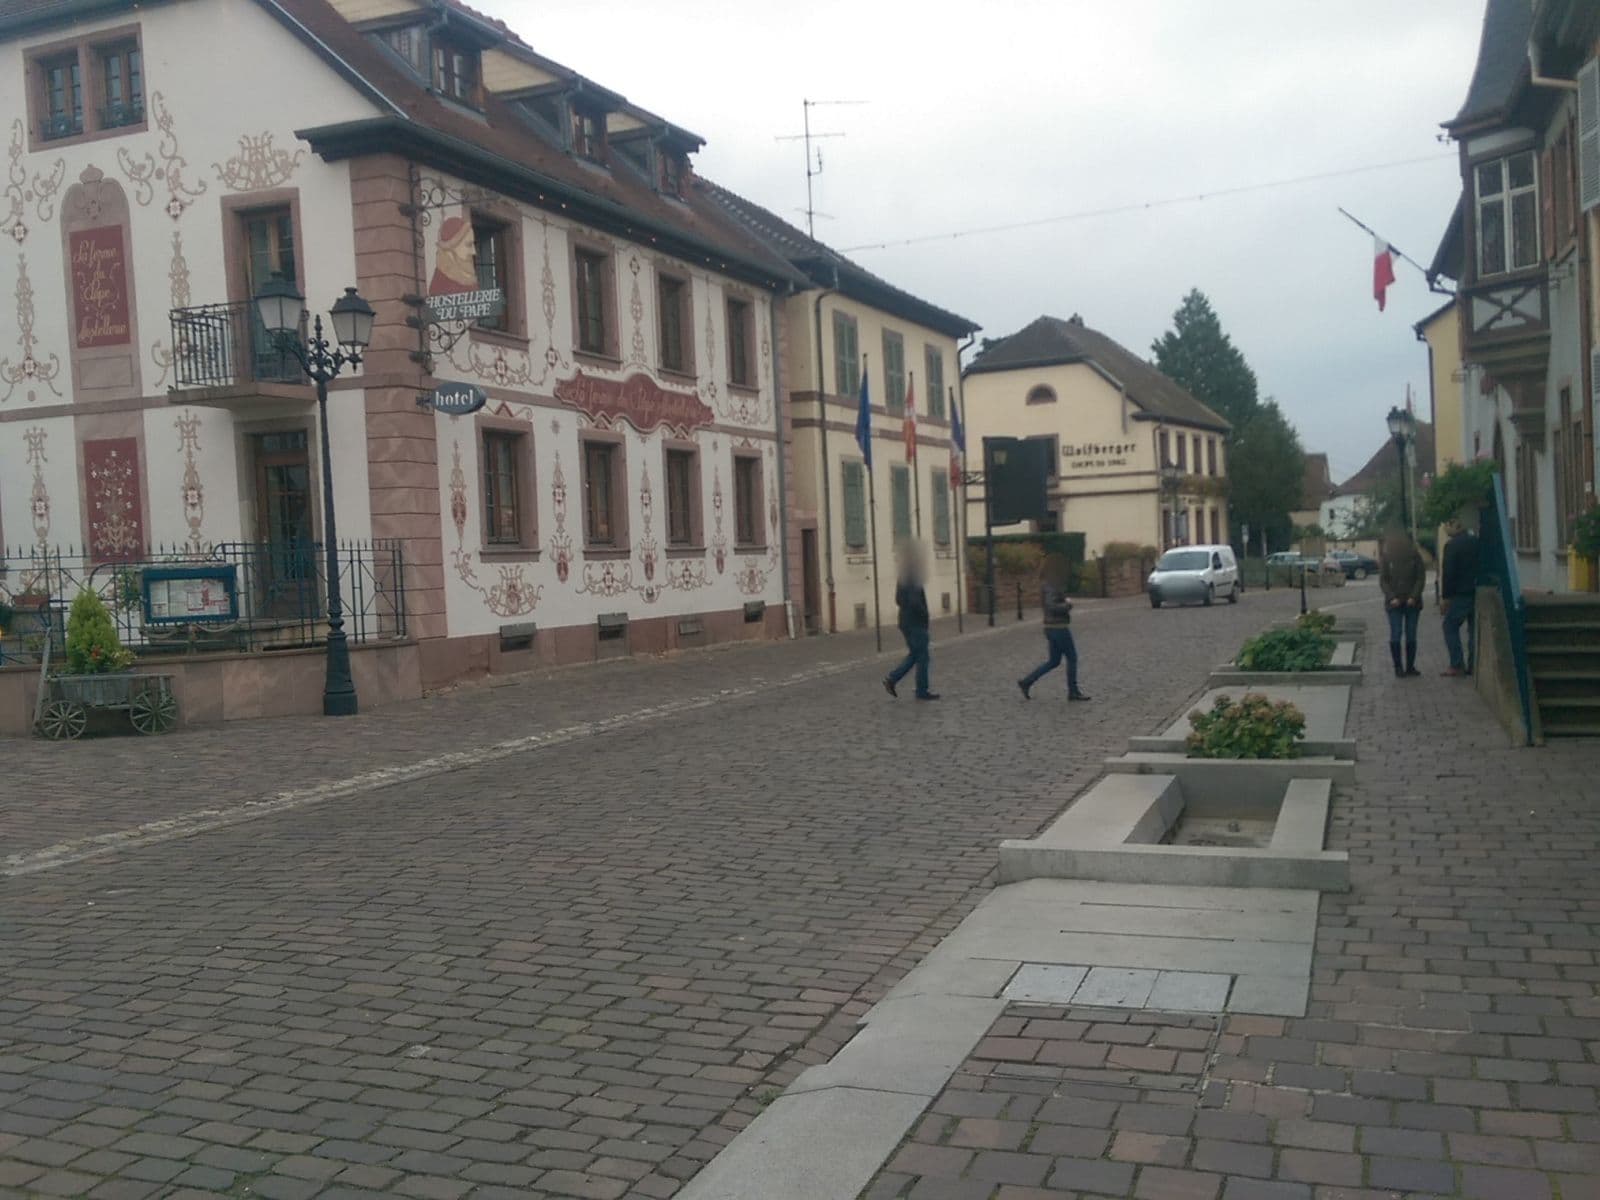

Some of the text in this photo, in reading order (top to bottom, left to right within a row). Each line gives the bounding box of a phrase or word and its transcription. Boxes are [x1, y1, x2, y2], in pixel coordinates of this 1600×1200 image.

[426, 288, 501, 308] HOSTELLERIE
[436, 303, 492, 320] DU PAPE
[435, 389, 474, 406] hotel
[1062, 443, 1136, 457] Wolfberger
